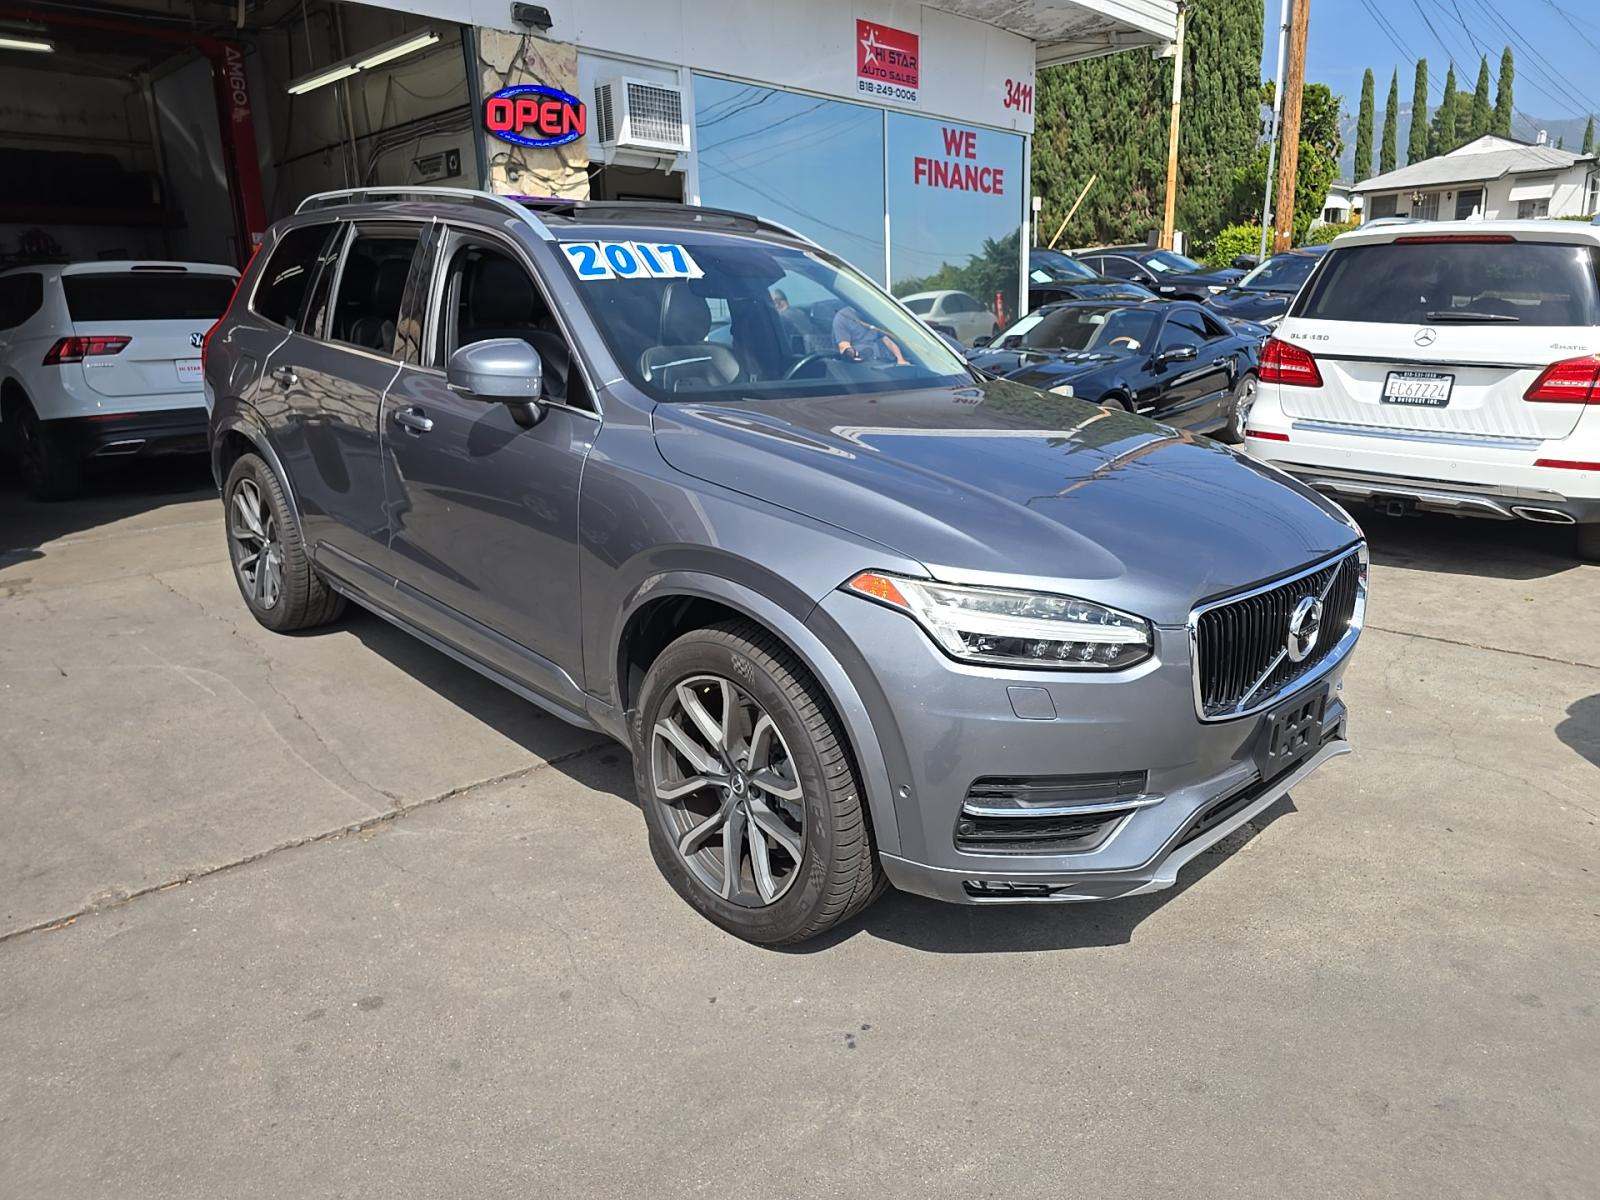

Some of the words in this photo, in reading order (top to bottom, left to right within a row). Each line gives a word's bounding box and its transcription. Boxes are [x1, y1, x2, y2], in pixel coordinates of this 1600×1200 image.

[862, 65, 887, 78] AUTO
[889, 71, 917, 84] SALES
[875, 47, 886, 62] HI
[888, 51, 917, 70] STAR
[225, 46, 247, 105] AMGO
[859, 80, 917, 102] 818-249-0006
[1003, 79, 1032, 114] 3411
[486, 98, 586, 135] OPEN
[942, 127, 977, 160] WE
[914, 156, 1004, 195] FINANCE
[567, 244, 689, 276] 2017
